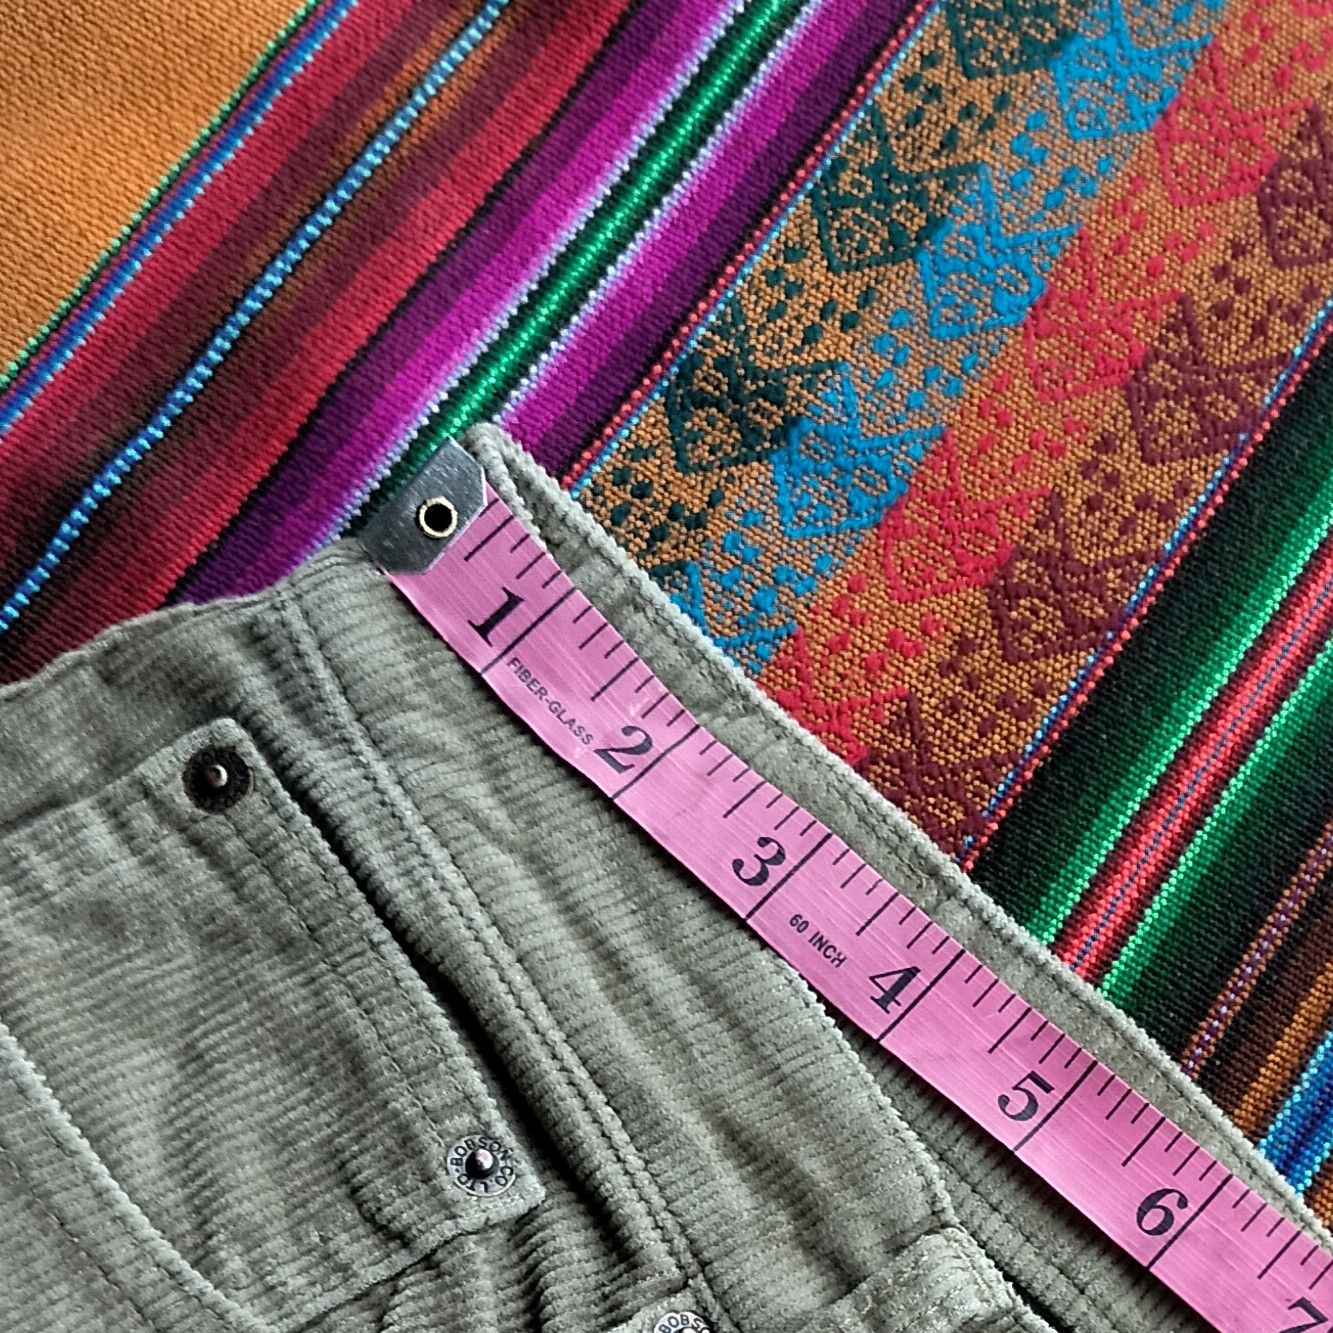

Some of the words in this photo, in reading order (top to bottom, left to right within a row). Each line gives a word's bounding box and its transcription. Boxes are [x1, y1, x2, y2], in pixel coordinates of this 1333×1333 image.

[467, 587, 525, 647] 1
[507, 657, 594, 746] FIBER-GLASS
[594, 724, 654, 774] 2
[731, 835, 787, 888] 3
[789, 913, 809, 933] 60
[808, 926, 848, 968] INCH
[868, 963, 921, 1013] 4
[997, 1074, 1055, 1122] 5
[1136, 1188, 1189, 1238] 6
